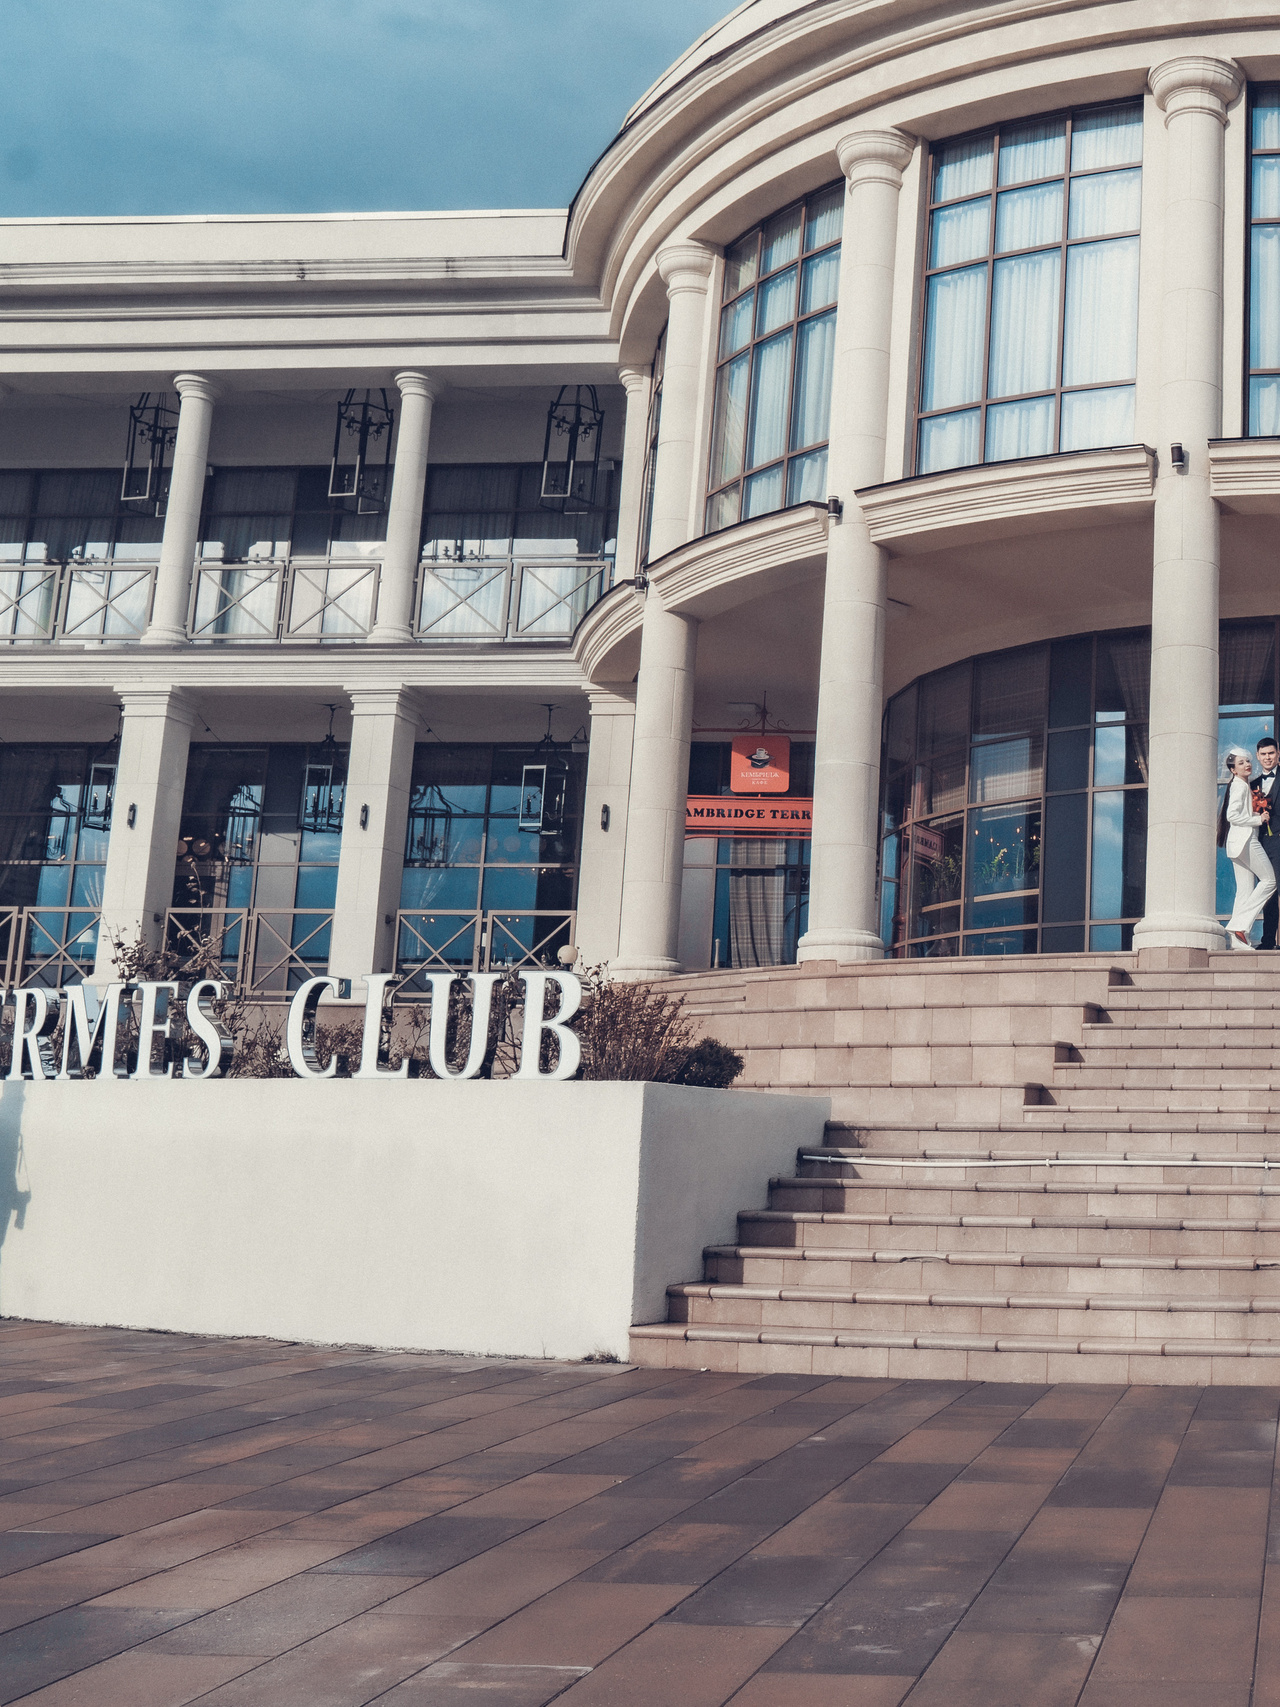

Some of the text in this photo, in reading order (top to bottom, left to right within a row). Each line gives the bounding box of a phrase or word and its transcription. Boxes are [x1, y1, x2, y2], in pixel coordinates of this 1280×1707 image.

[770, 809, 811, 820] TERR
[0, 971, 582, 1080] RMES CLUB
